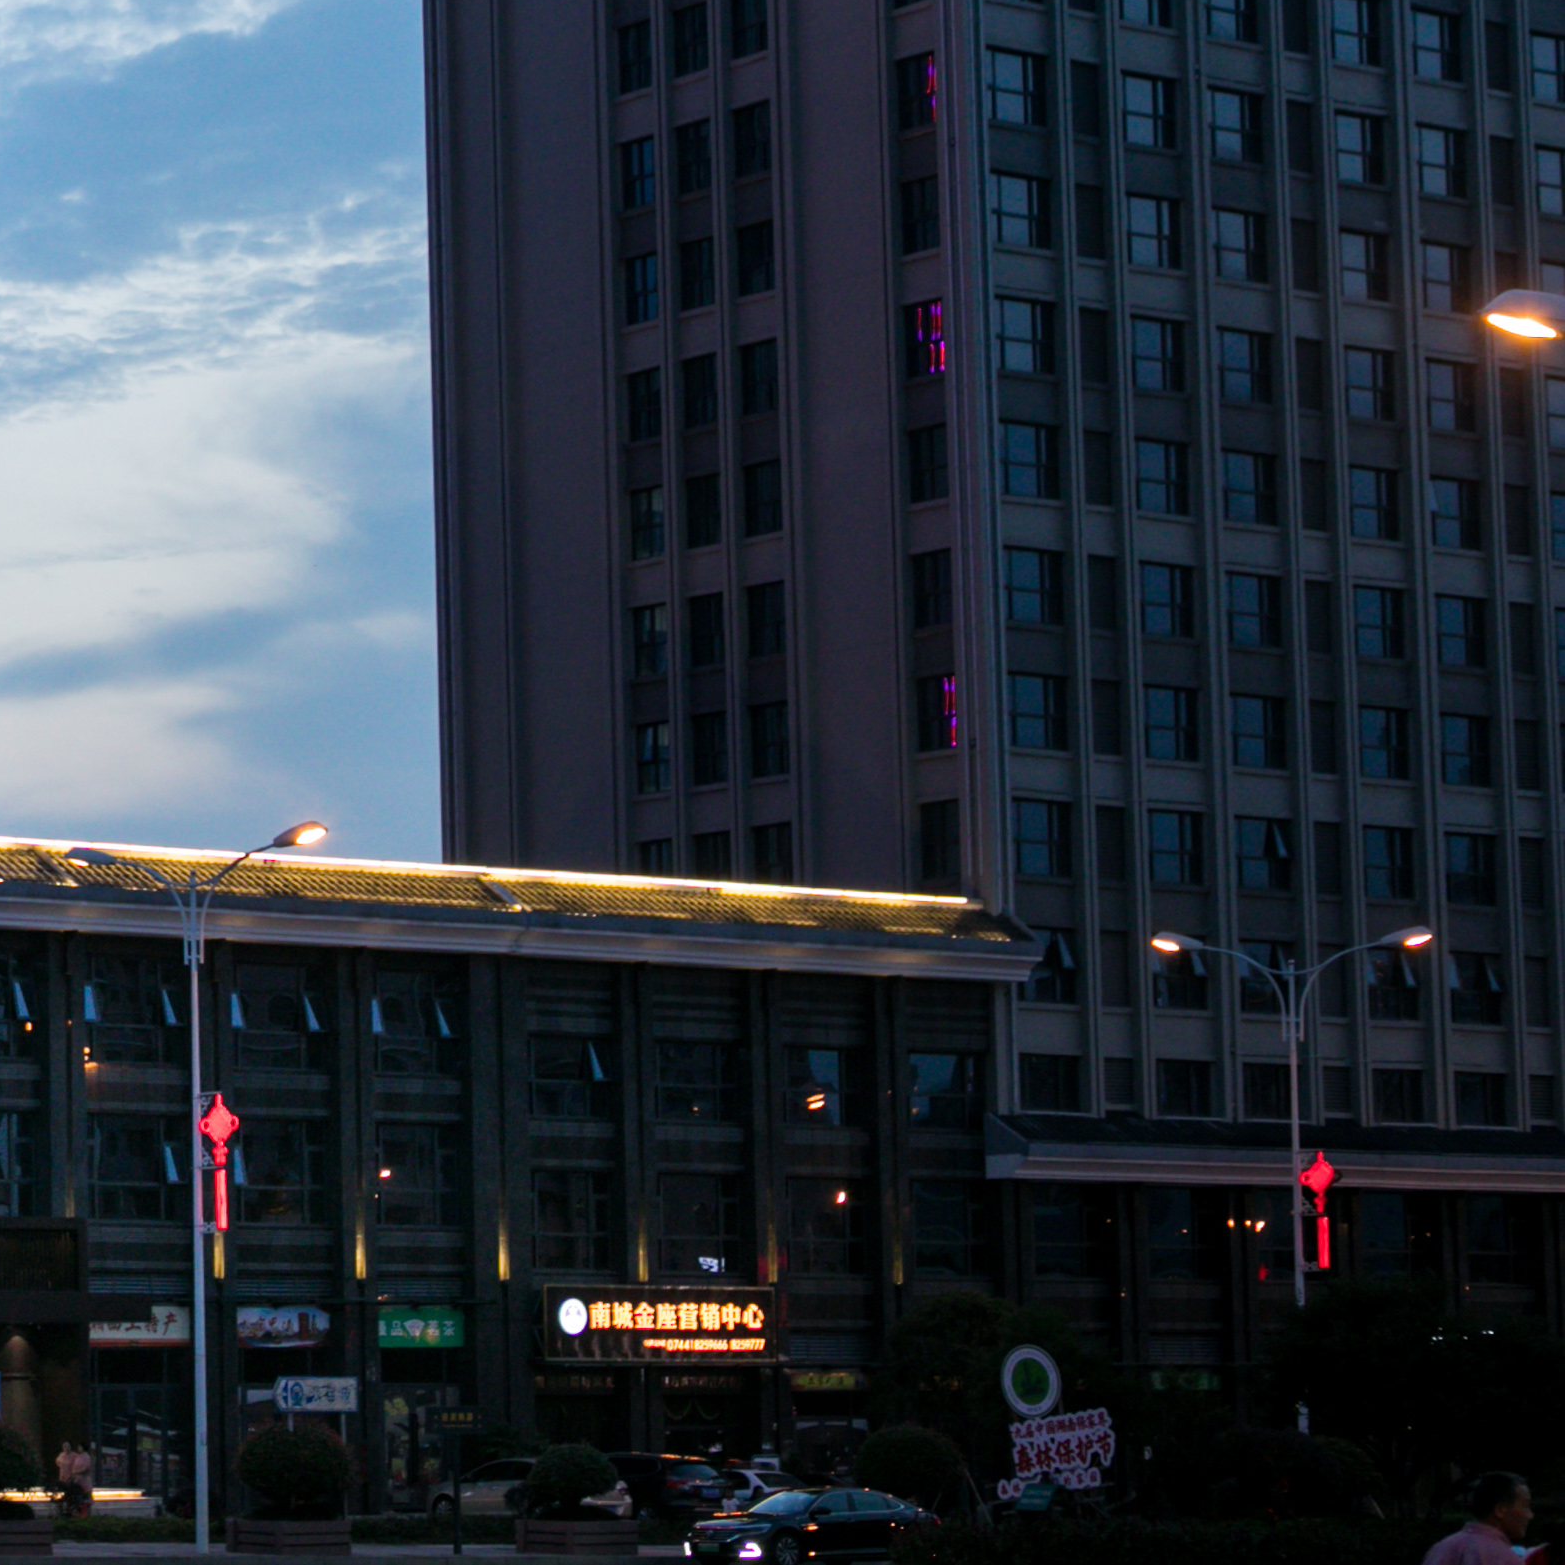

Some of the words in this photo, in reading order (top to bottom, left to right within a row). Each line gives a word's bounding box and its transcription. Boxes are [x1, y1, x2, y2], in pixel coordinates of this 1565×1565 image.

[588, 1302, 762, 1331] 南城金座营销中心
[666, 1339, 690, 1351] 0744
[693, 1339, 728, 1351] 8259666
[729, 1338, 765, 1351] 8259777
[1015, 1431, 1112, 1474] 森林保护节
